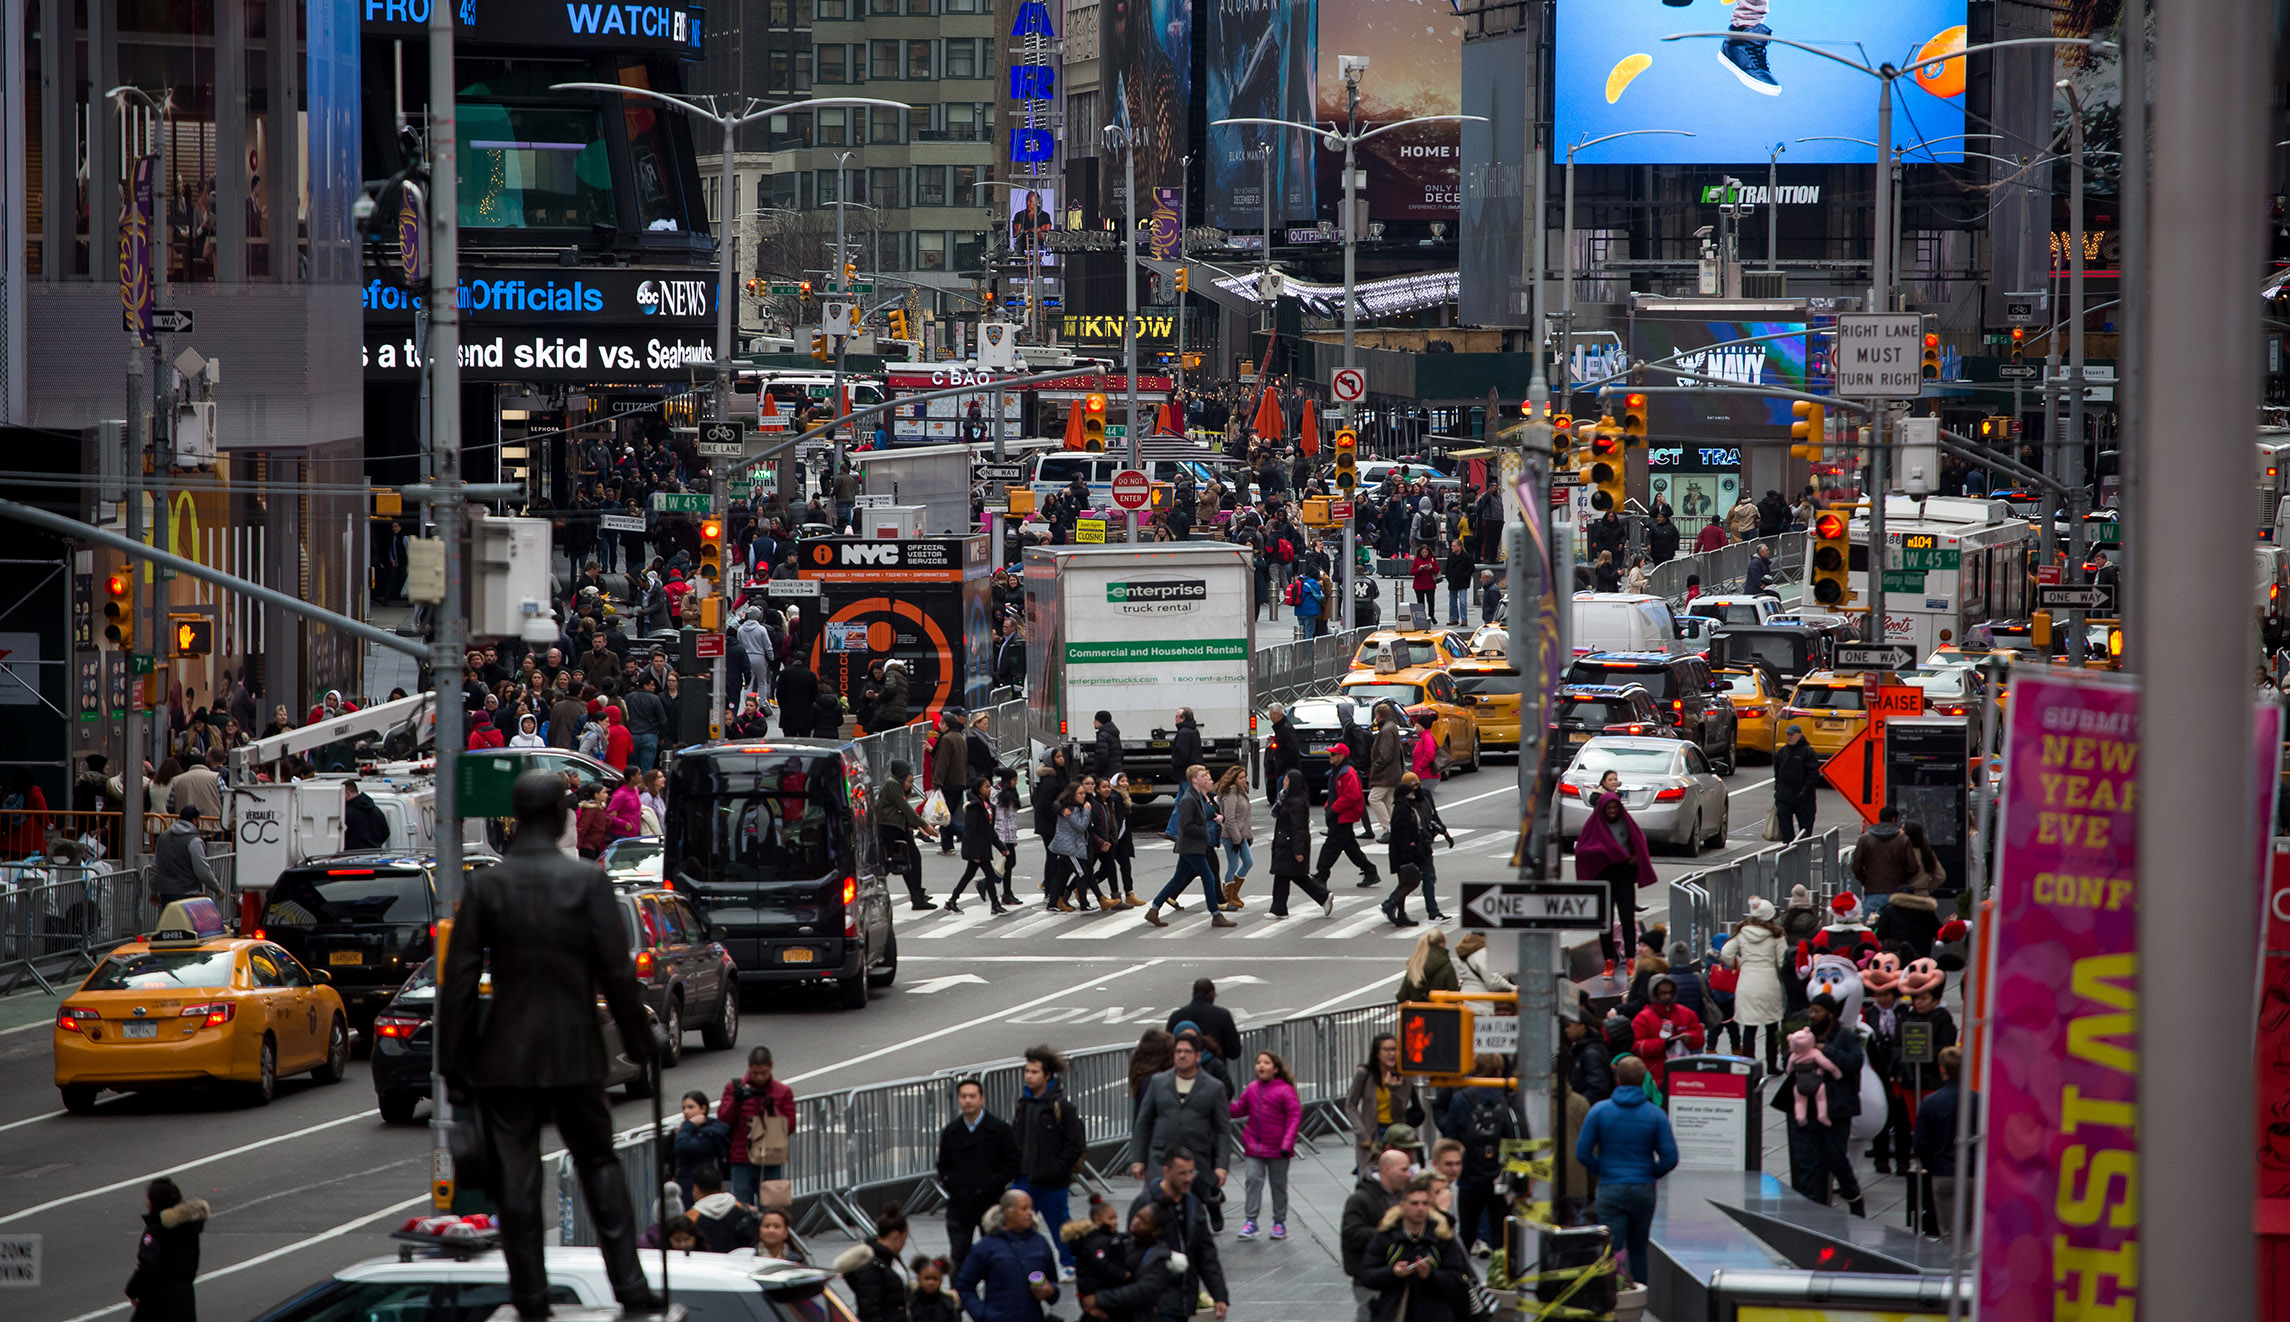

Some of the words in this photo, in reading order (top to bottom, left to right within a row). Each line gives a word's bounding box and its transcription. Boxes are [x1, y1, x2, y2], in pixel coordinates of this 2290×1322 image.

[567, 4, 670, 36] WATCH
[1401, 146, 1450, 158] HOME
[1425, 184, 1451, 192] ONLY
[1425, 192, 1460, 203] DECE
[1290, 231, 1339, 243] OUTFRT
[473, 279, 604, 312] Officials
[660, 280, 706, 316] NEWS
[162, 317, 184, 326] WAY
[1841, 325, 1880, 338] RIGHT
[1886, 325, 1918, 337] LANE
[514, 337, 587, 369] skid
[599, 346, 641, 369] vs.
[647, 338, 713, 370] Seahawks
[1857, 348, 1902, 362] MUST
[1708, 354, 1765, 385] NAVY
[2085, 369, 2105, 377] Square
[932, 372, 943, 385] C
[950, 371, 990, 386] BAO
[1841, 373, 1876, 386] TURN
[1881, 373, 1918, 386] RIGHT
[613, 402, 658, 412] CITIZEN
[1106, 427, 1116, 437] 44
[701, 444, 717, 454] BIKE
[720, 444, 741, 454] LANE
[1118, 477, 1129, 485] DO
[1131, 477, 1143, 485] NOT
[669, 496, 679, 508] W
[684, 496, 698, 510] 45
[1119, 495, 1142, 503] ENTER
[1077, 531, 1104, 541] CLOSING
[2103, 526, 2114, 539] W
[841, 544, 899, 565] NYC
[1906, 552, 1918, 567] W
[1925, 551, 1942, 567] 45
[1948, 552, 1958, 562] St
[1883, 574, 1902, 588] George
[1904, 574, 1923, 585] Abbott
[1110, 583, 1205, 600] enterprise
[2050, 593, 2071, 602] ONE
[2080, 593, 2103, 602] WAY
[1123, 604, 1153, 613] truck
[1157, 602, 1191, 613] rental
[1069, 647, 1127, 657] Commercial
[1129, 647, 1149, 657] and
[1151, 646, 1205, 656] Household
[1206, 645, 1243, 655] Rentals
[1845, 652, 1869, 663] ONE
[1880, 652, 1905, 663] WAY
[136, 658, 142, 671] 7
[1069, 676, 1159, 685] enterprisetrucks.com
[1195, 674, 1246, 682] rent-a-truck
[1872, 695, 1918, 710] RAISE
[2041, 734, 2138, 773] NEW
[245, 809, 275, 820] VERSALIFT
[2037, 811, 2110, 849] EVE
[2033, 872, 2139, 911] CONF
[1482, 896, 1523, 916] ONE
[1544, 895, 1591, 916] WAY
[0, 1264, 34, 1281] VING
